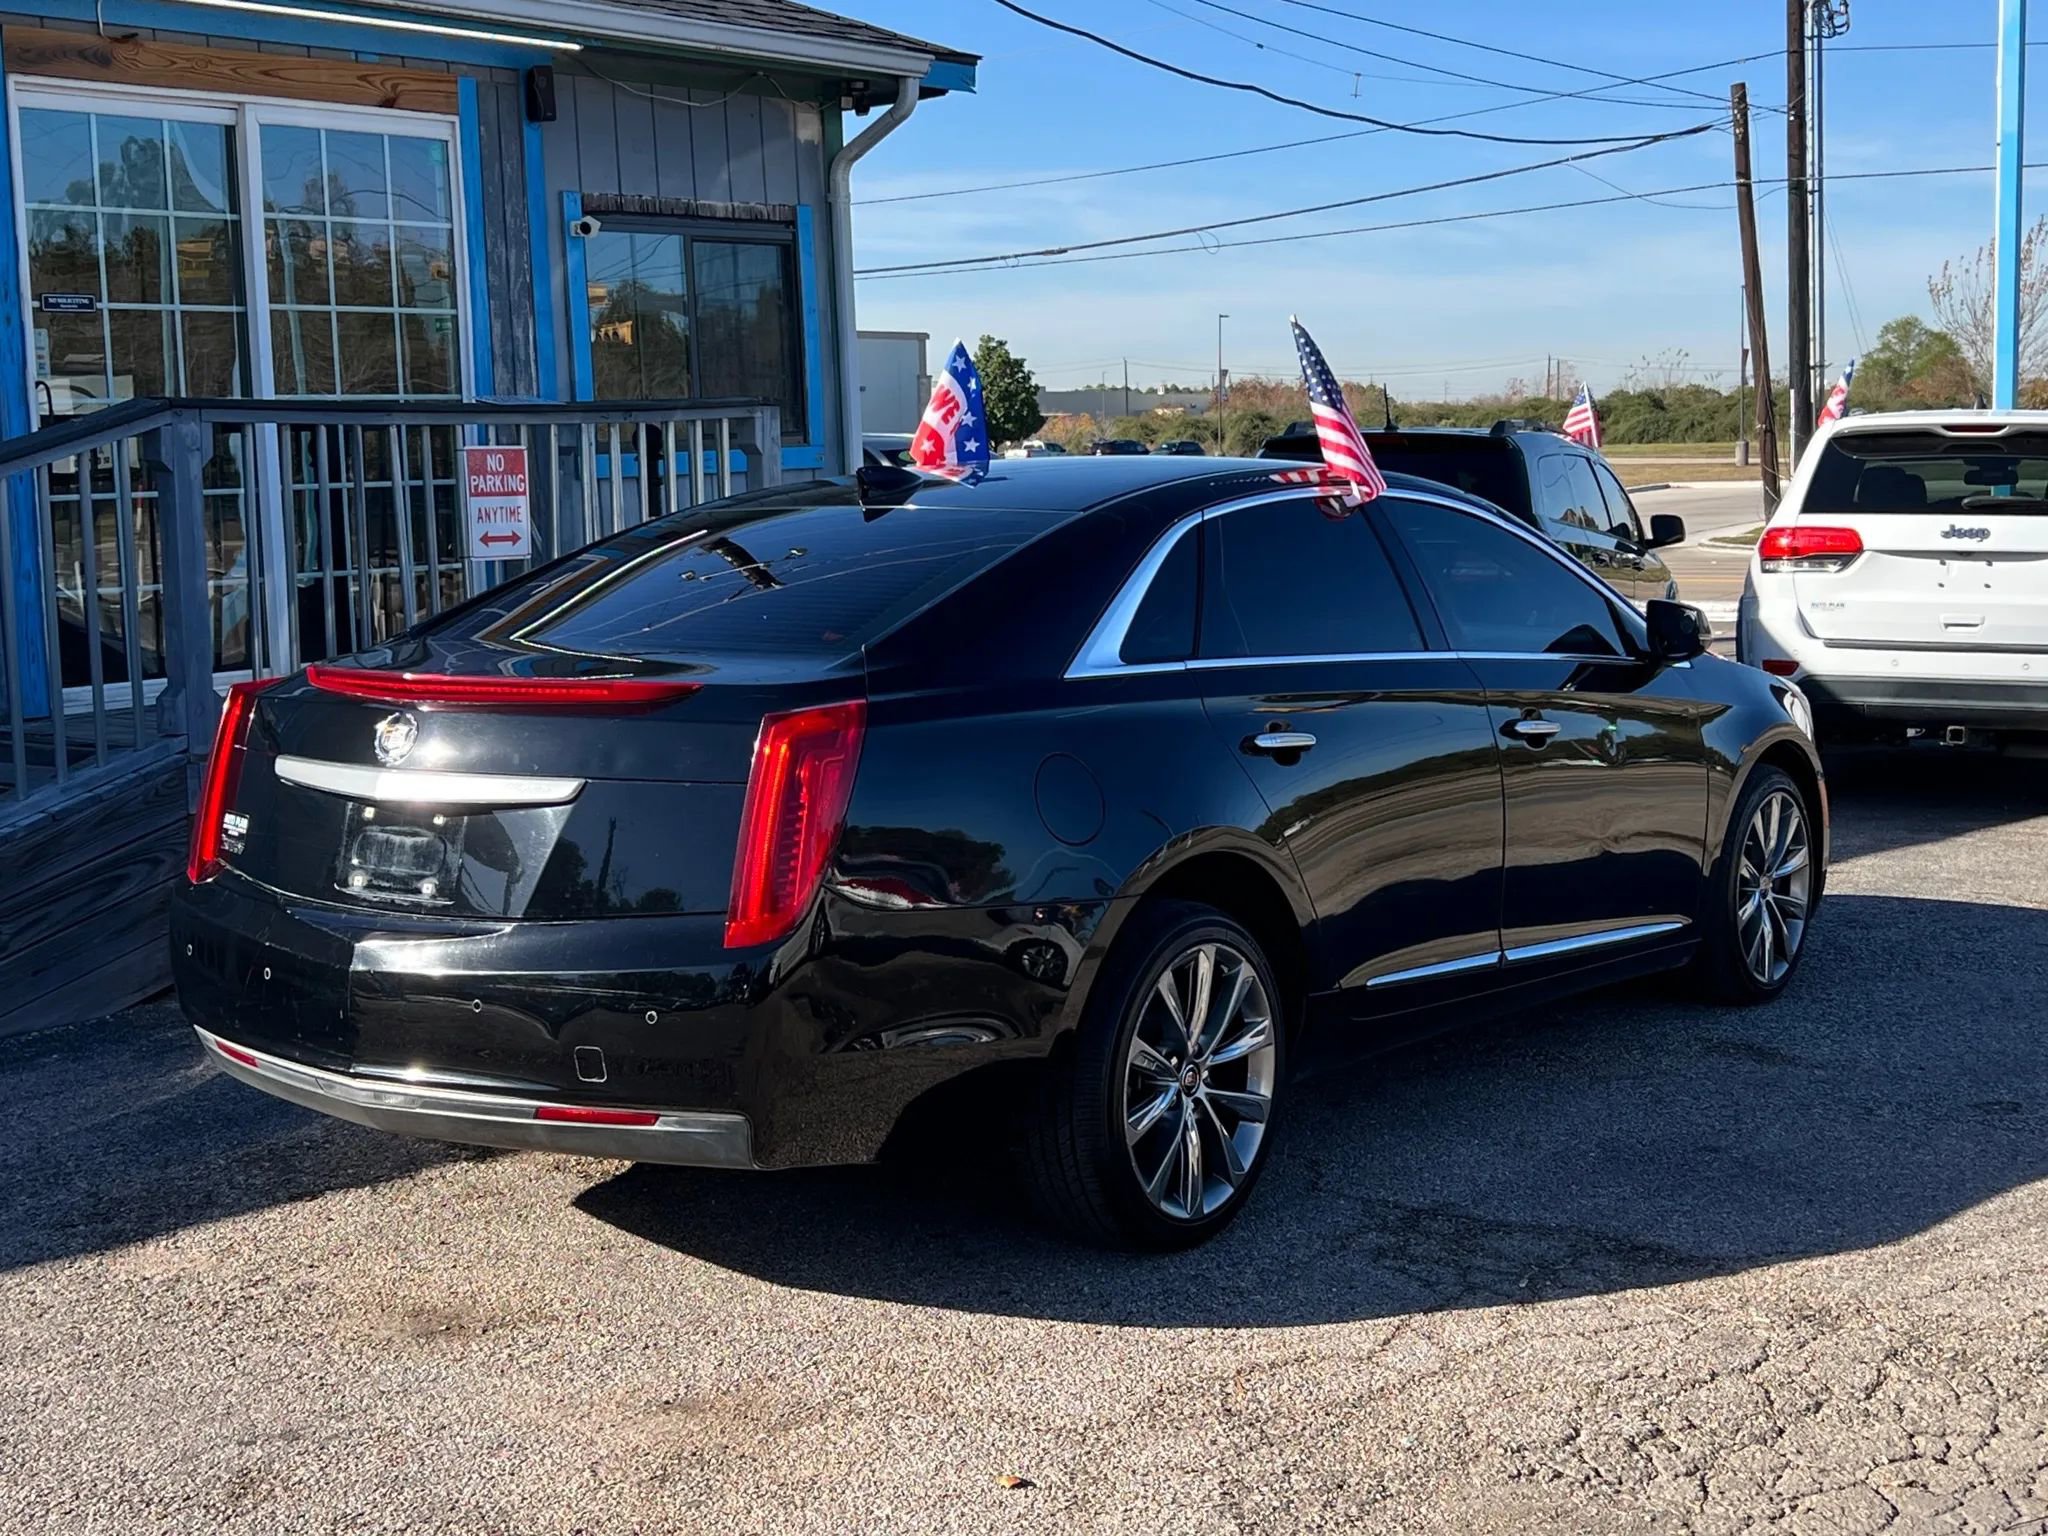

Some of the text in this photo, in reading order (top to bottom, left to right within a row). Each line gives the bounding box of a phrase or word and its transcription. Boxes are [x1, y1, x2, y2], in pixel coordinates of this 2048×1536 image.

[486, 454, 505, 472] NO
[470, 474, 525, 493] PARKING
[476, 506, 523, 524] ANYTIME
[1941, 524, 1991, 542] Jeep
